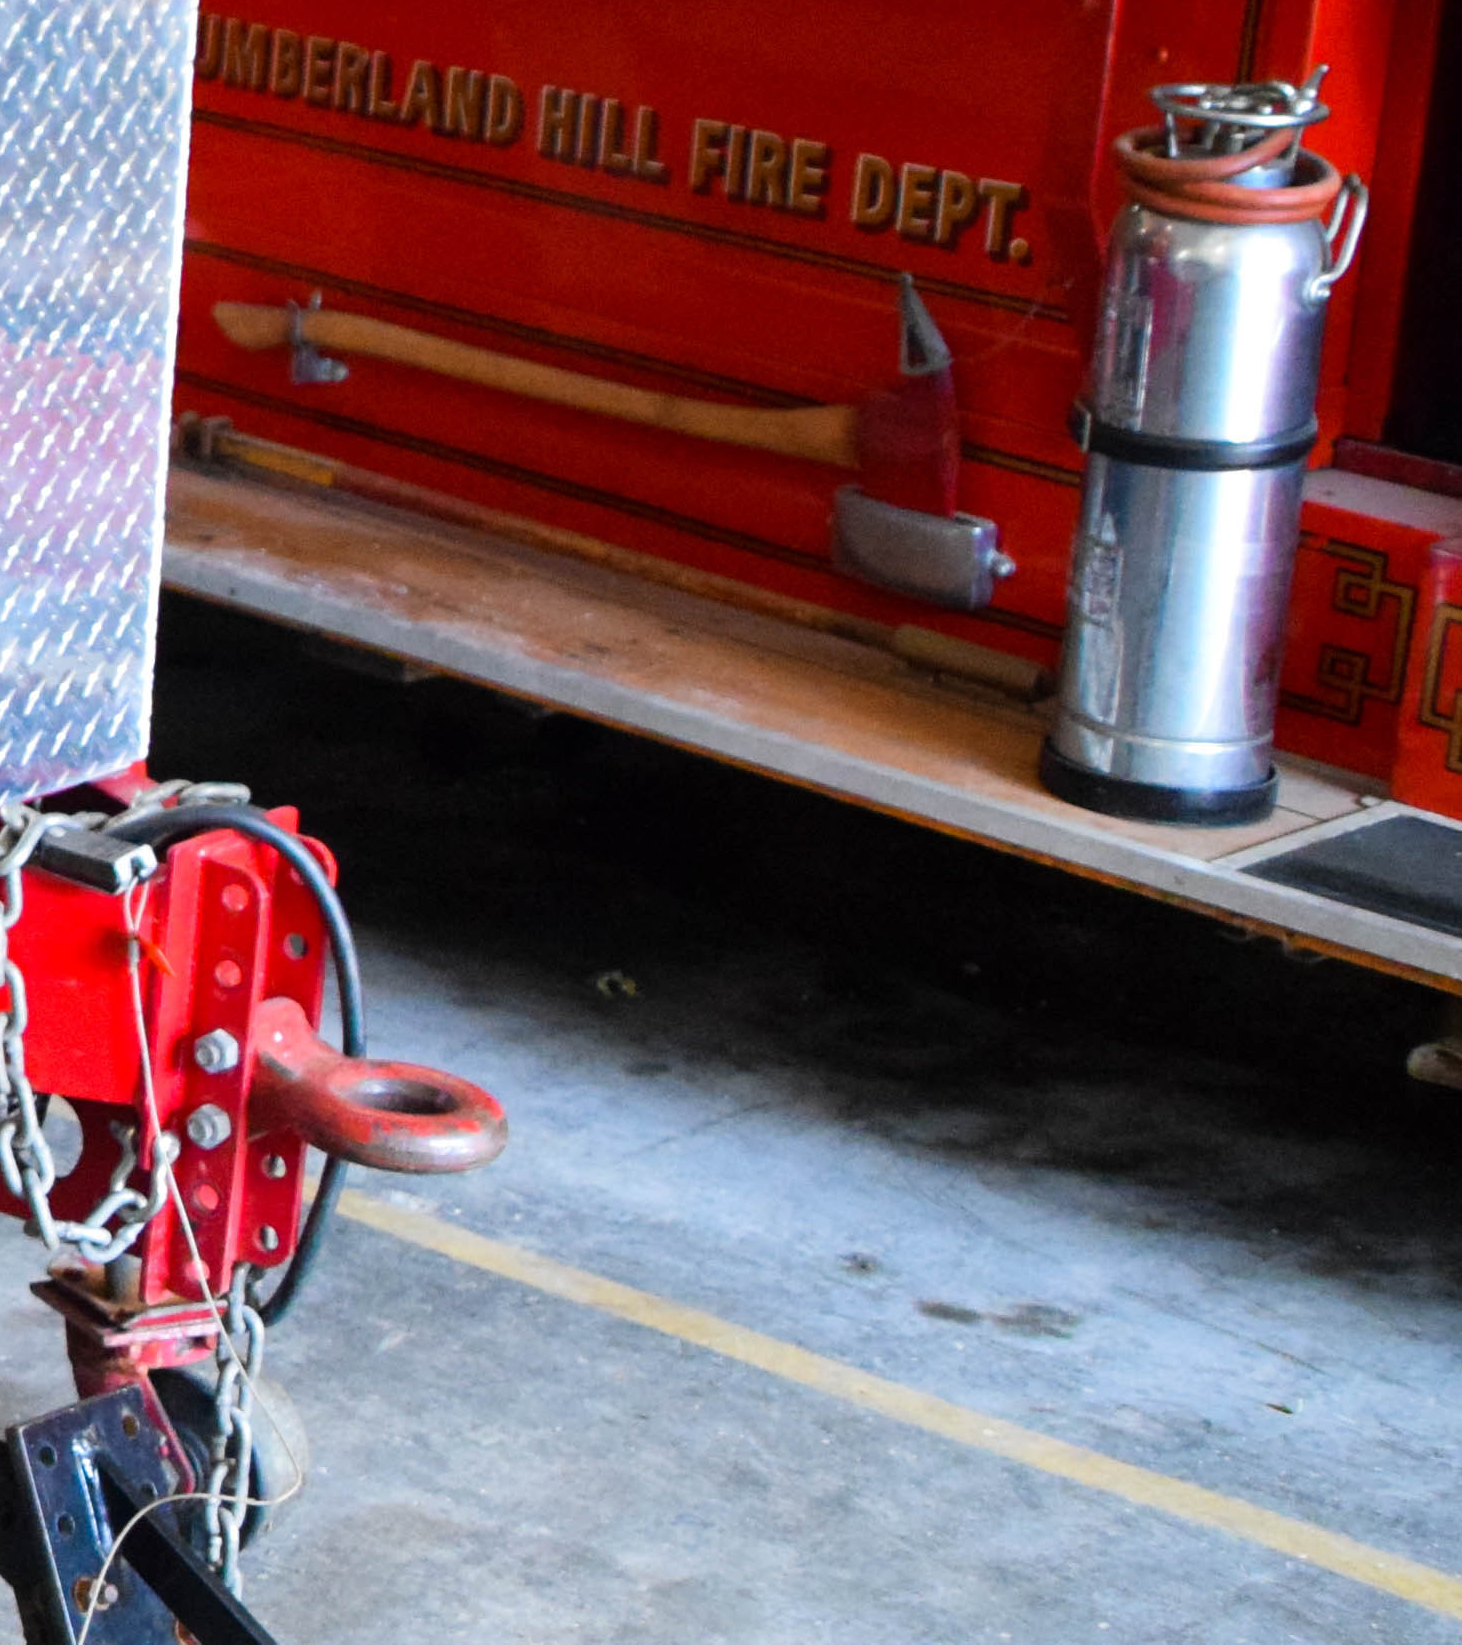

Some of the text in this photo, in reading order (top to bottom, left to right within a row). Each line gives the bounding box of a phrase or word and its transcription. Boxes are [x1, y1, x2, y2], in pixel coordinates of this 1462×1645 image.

[196, 13, 1035, 263] UMBERLAND HILL FIRE DEPT.
